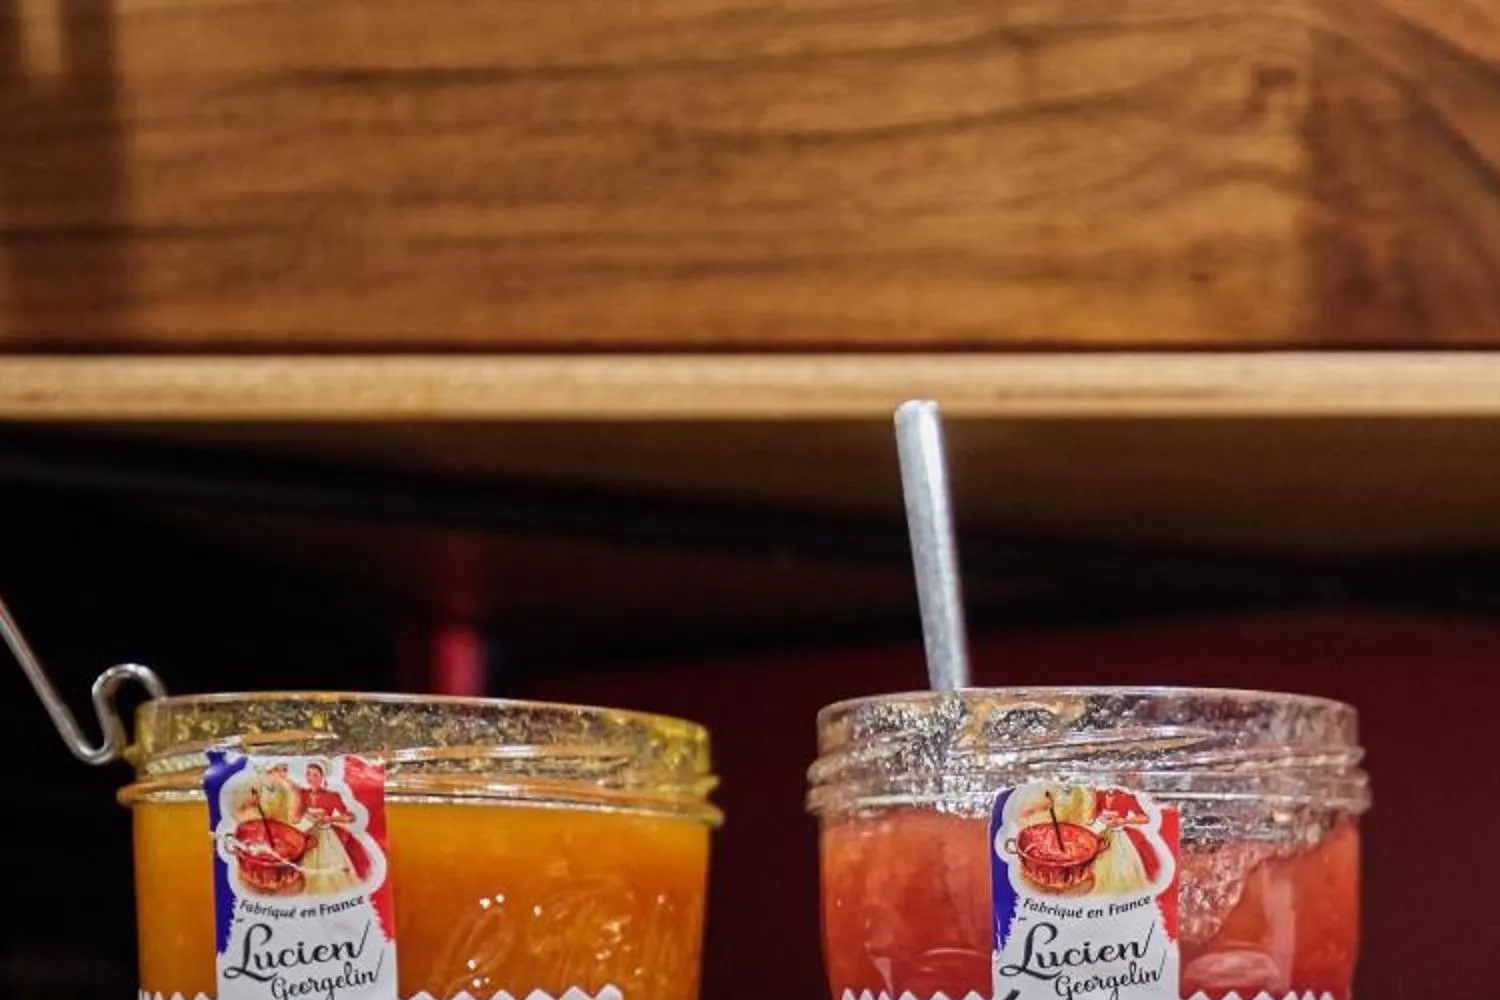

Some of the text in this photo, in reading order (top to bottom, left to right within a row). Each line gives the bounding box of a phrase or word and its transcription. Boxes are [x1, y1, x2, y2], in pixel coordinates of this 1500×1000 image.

[300, 907, 317, 918] en
[319, 895, 365, 916] France
[1087, 909, 1104, 919] en
[1109, 895, 1151, 916] France
[223, 919, 372, 983] Lucien
[999, 919, 1155, 981] Lucien
